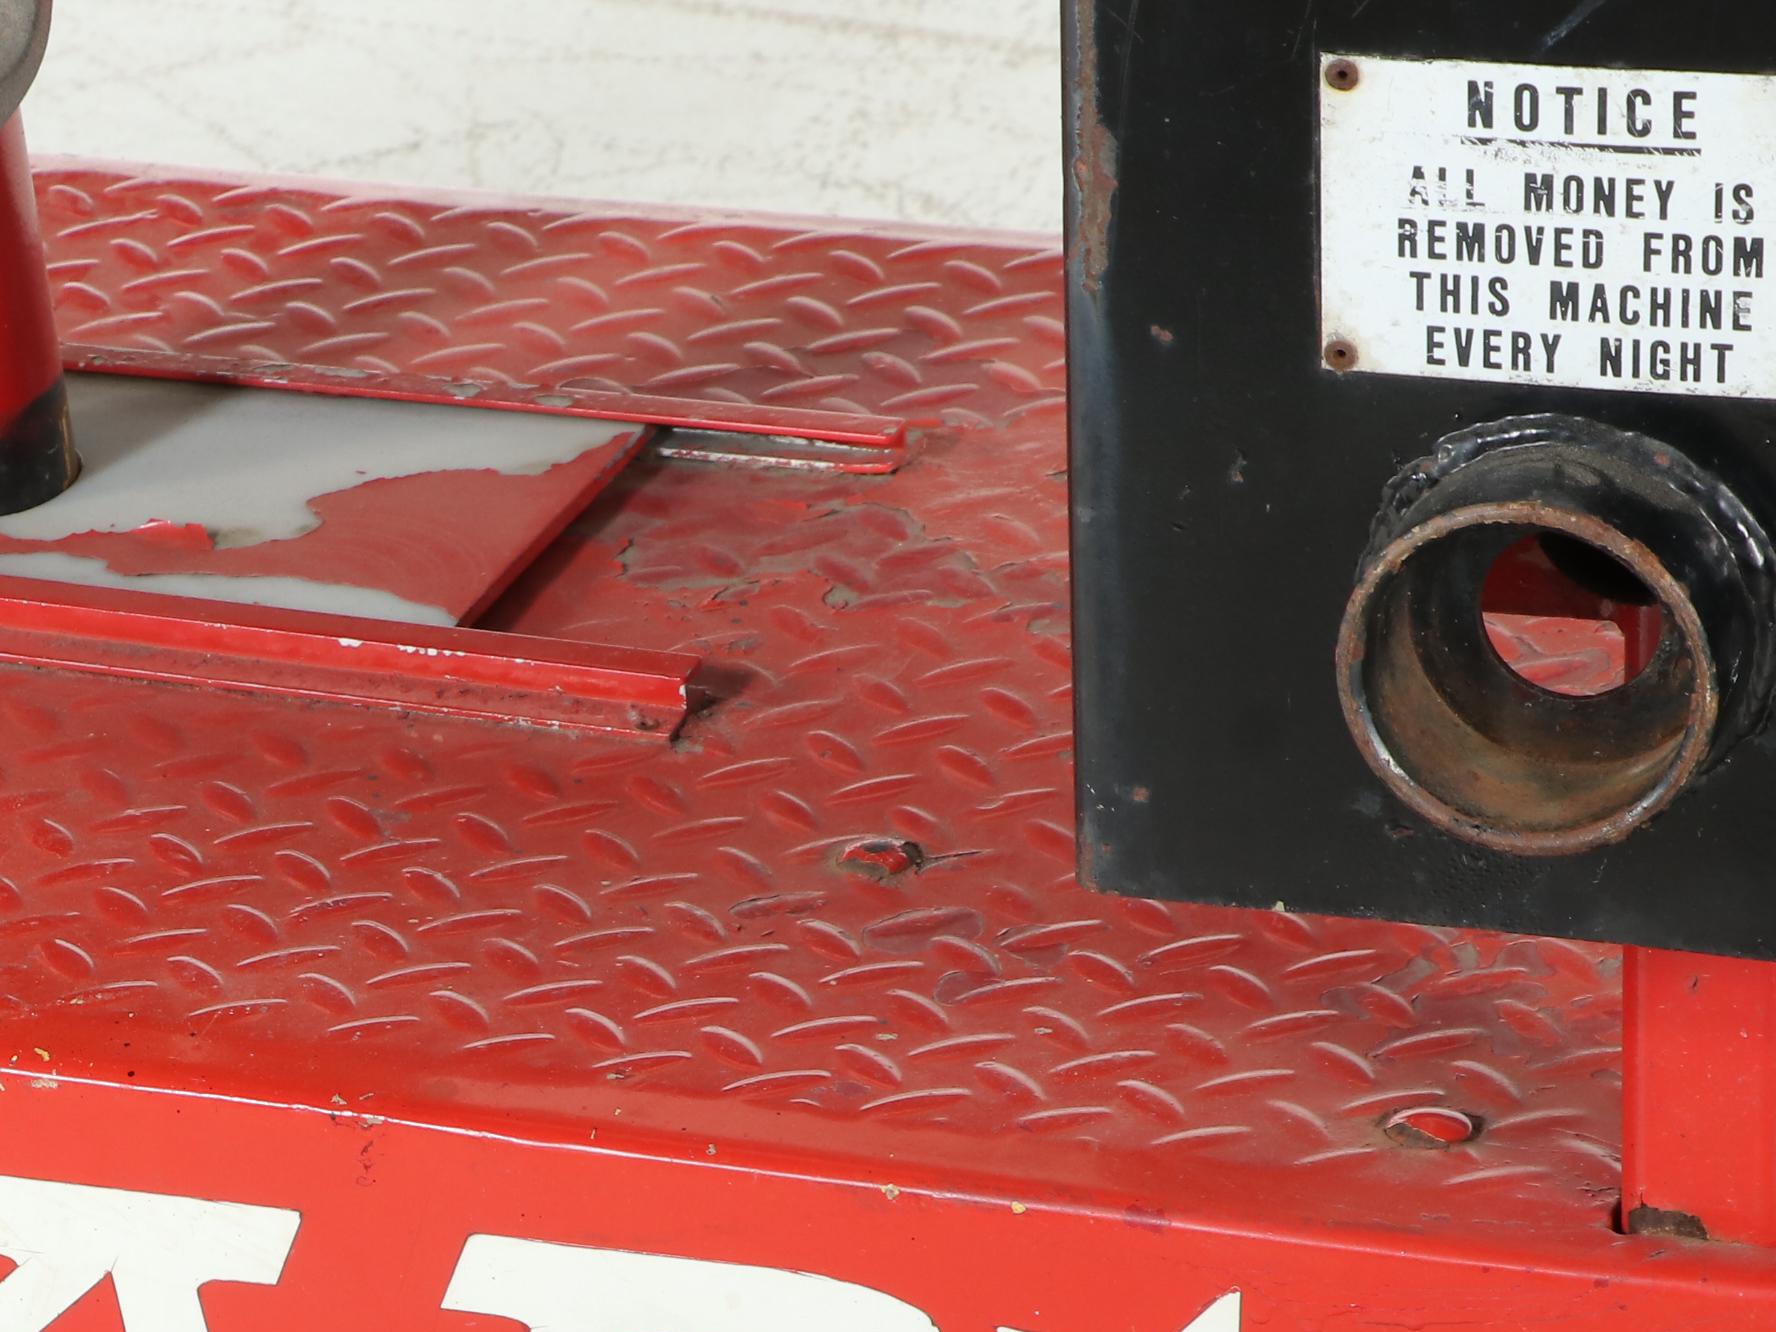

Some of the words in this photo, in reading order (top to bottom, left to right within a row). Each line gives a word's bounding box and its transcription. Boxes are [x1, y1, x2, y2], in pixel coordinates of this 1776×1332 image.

[1467, 80, 1698, 140] NOTICE
[1408, 165, 1485, 207] ALL
[1523, 172, 1675, 220] MONEY
[1714, 182, 1755, 225] IS
[1397, 218, 1604, 269] REMOVED
[1642, 232, 1764, 278] FROM
[1409, 271, 1510, 317] THIS
[1549, 280, 1753, 332] MACHINE
[1426, 325, 1562, 374] EVERY
[1599, 337, 1734, 384] NIGHT
